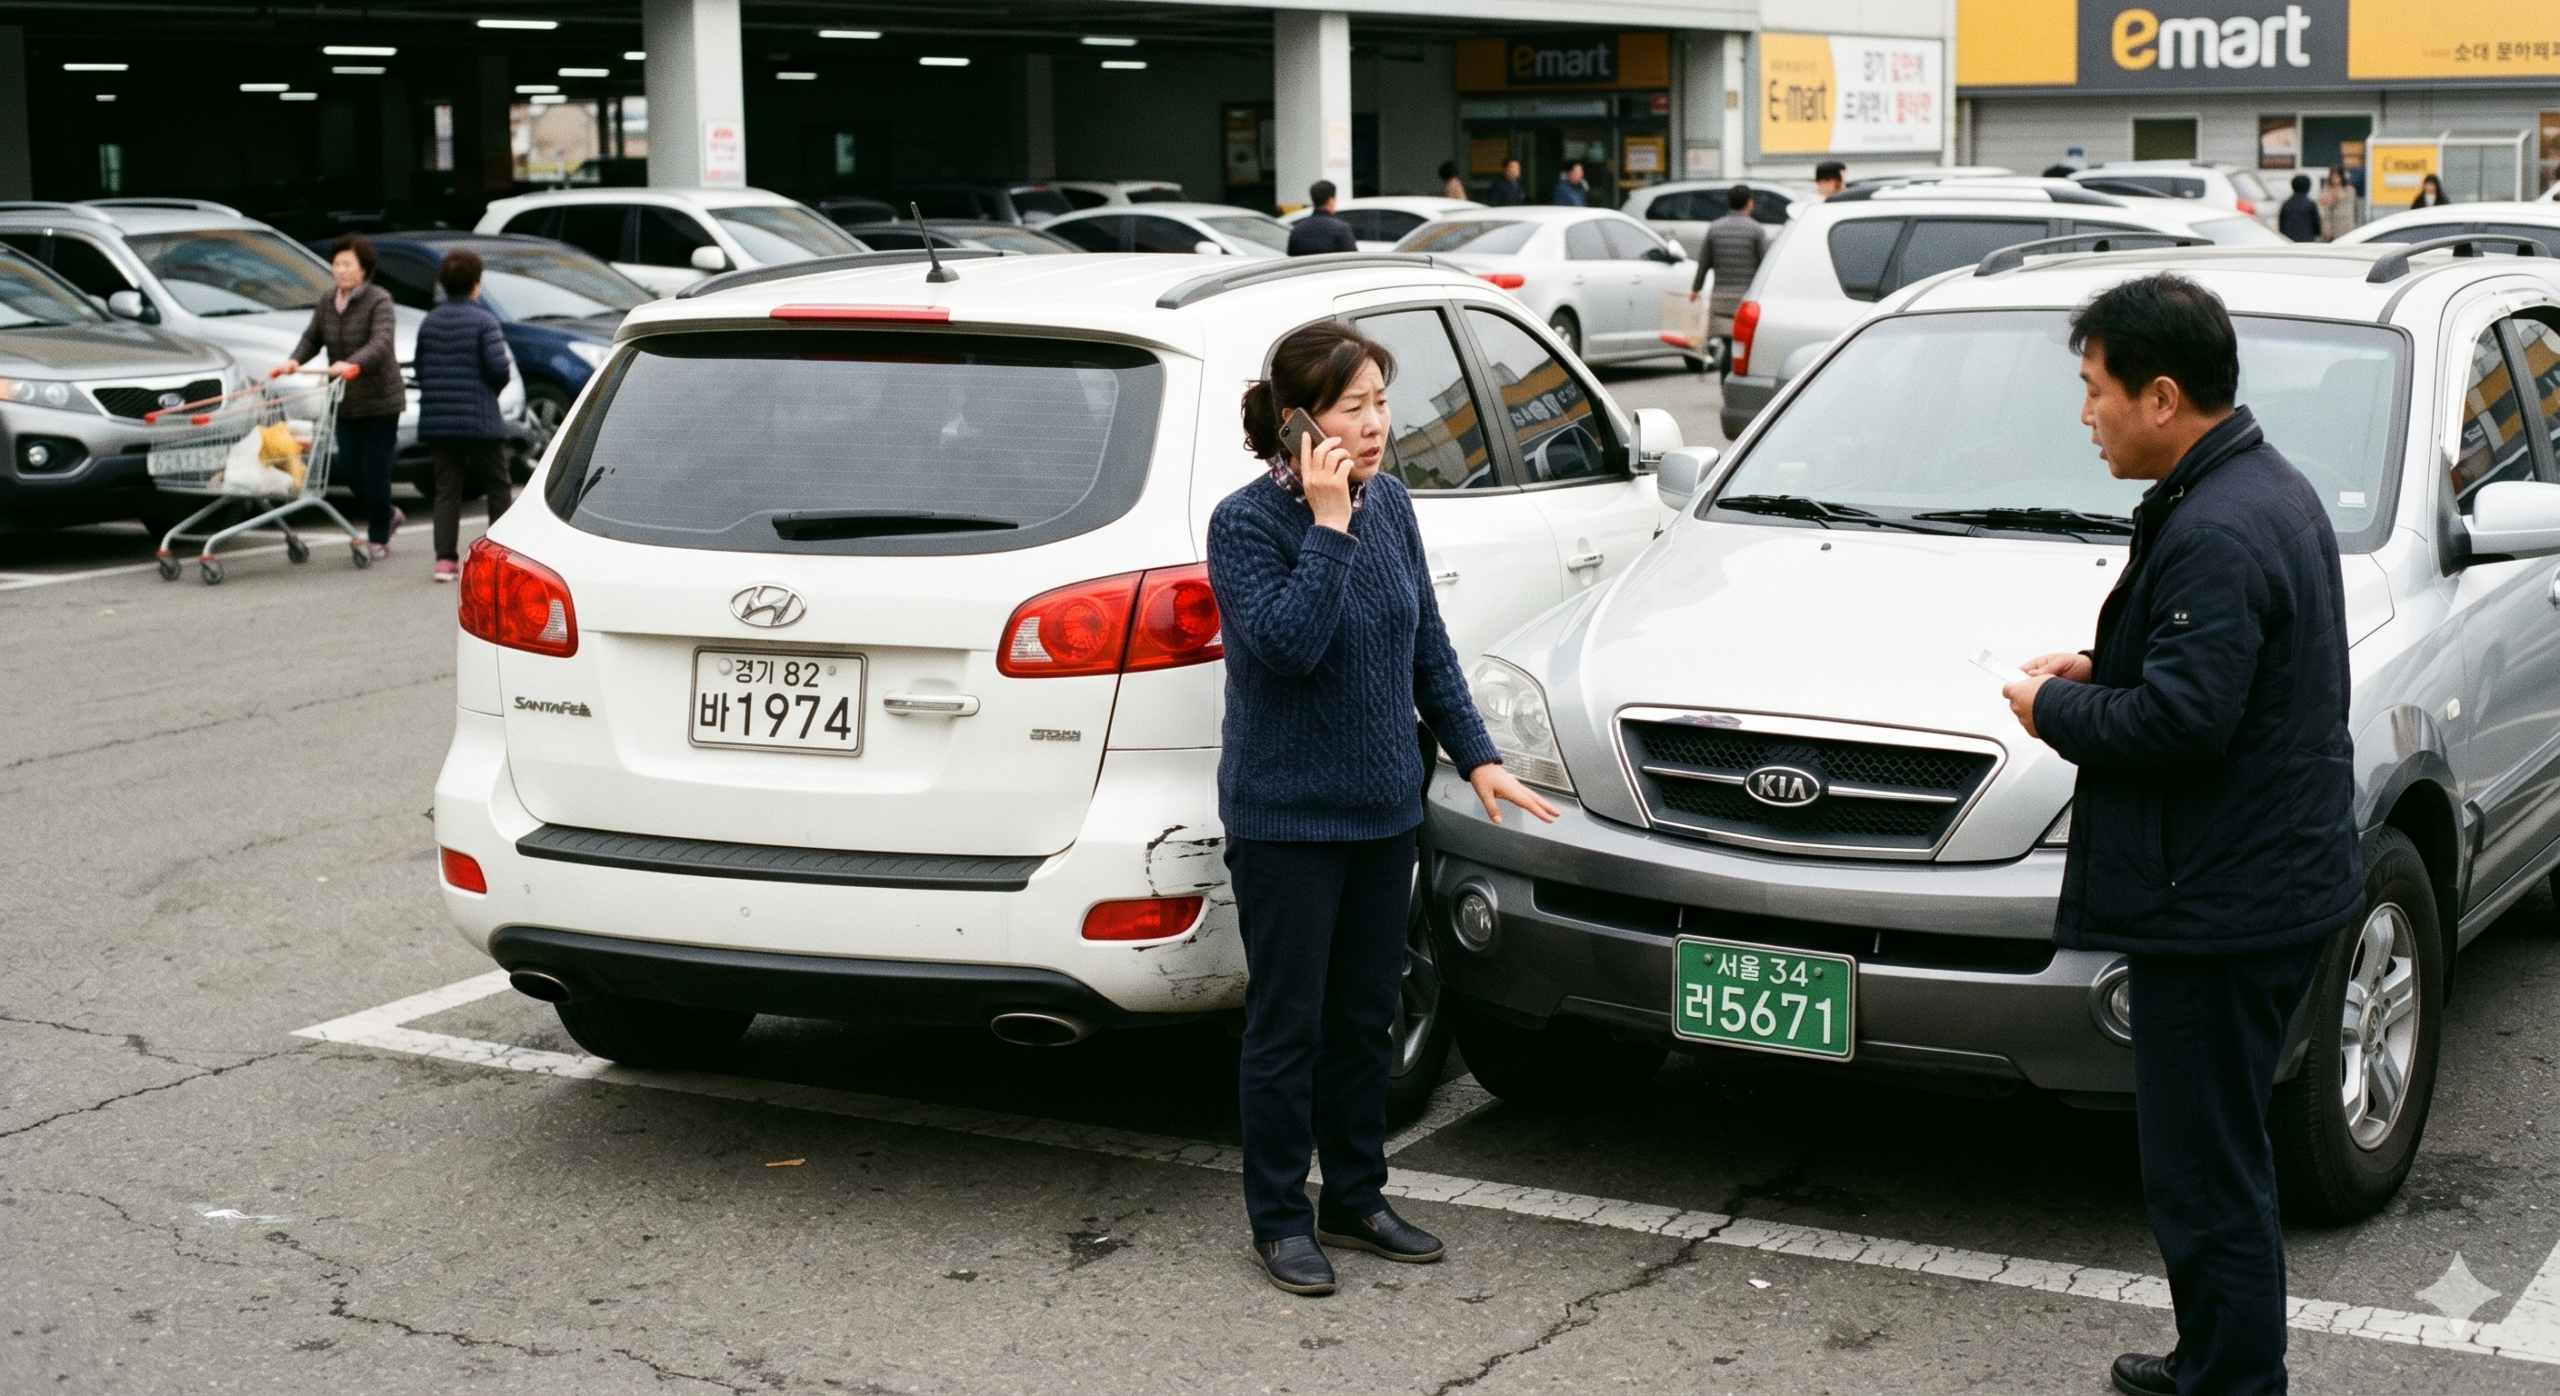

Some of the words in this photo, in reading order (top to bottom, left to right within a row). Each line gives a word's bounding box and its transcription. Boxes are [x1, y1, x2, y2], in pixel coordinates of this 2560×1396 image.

[2111, 4, 2312, 71] emart
[1512, 41, 1611, 78] emart
[735, 659, 774, 684] 경기
[783, 661, 820, 688] 82
[700, 691, 852, 741] 바1974
[1758, 774, 1807, 800] KIA
[1716, 953, 1760, 982] 서울
[1769, 957, 1809, 988] 34
[1685, 982, 1832, 1045] 러5671
